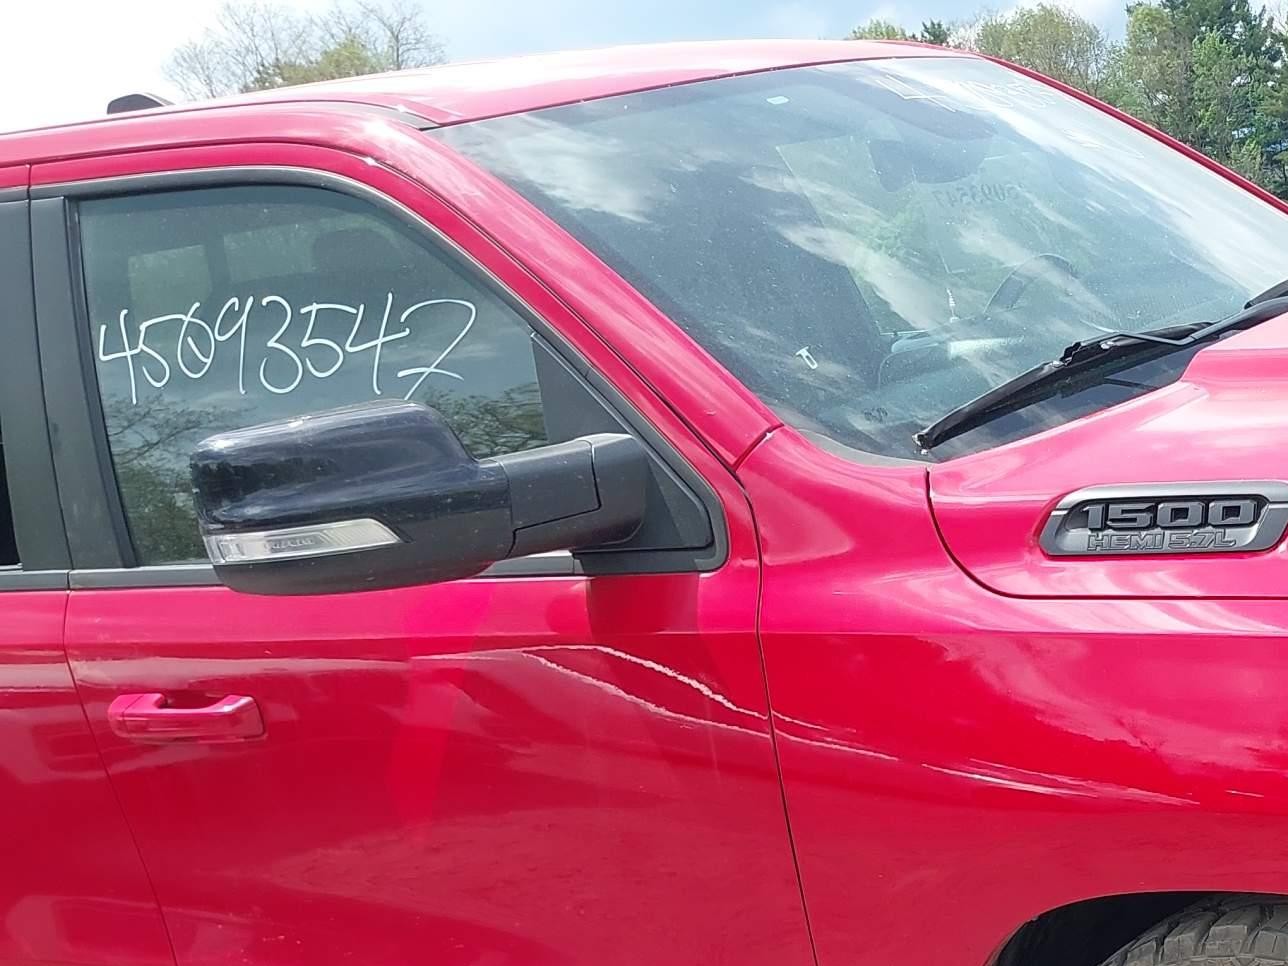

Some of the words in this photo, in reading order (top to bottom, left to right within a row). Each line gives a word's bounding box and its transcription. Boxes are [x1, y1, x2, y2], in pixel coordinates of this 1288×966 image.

[1082, 498, 1260, 530] 1500
[1087, 531, 1164, 551] HEMI
[1167, 529, 1236, 549] 5.7L
